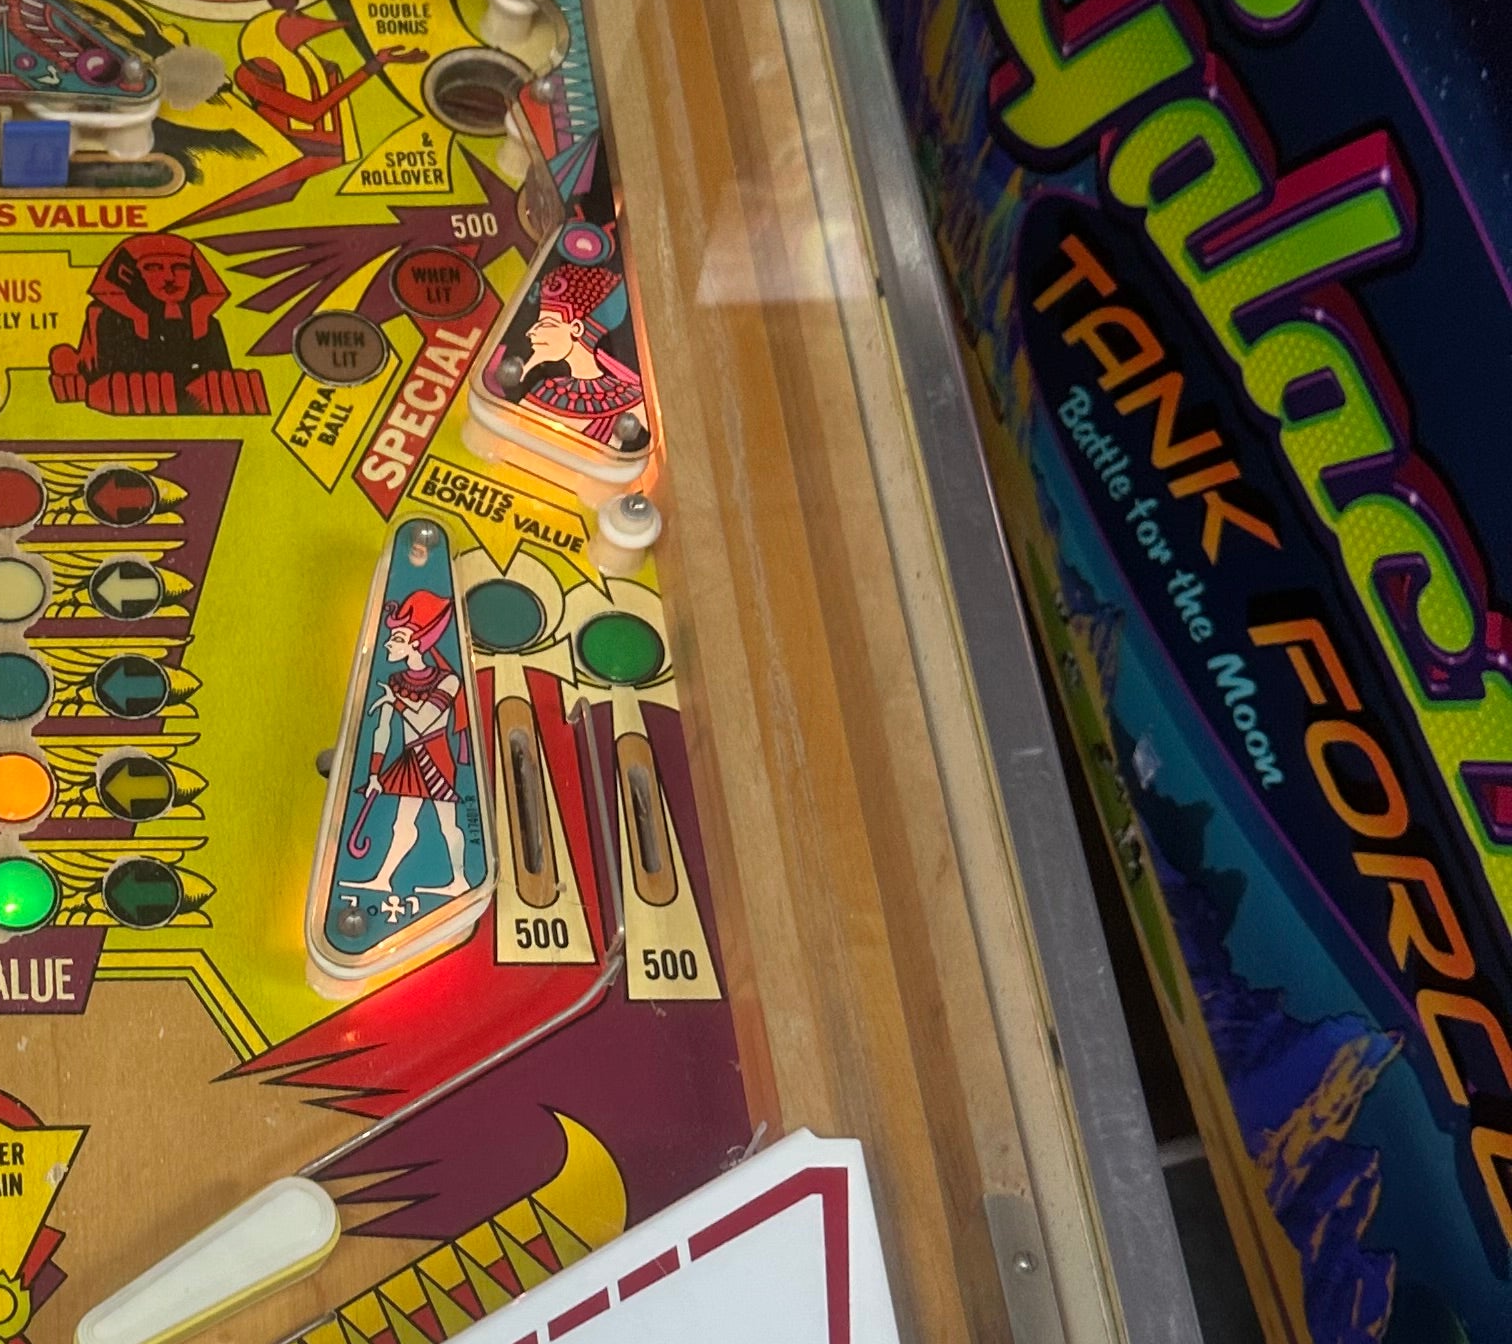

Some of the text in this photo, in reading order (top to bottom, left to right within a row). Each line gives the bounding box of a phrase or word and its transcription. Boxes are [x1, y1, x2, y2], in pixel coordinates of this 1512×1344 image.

[368, 3, 431, 19] DOUBLE
[377, 19, 428, 35] BONUS
[422, 132, 433, 148] &
[384, 150, 438, 168] SPOTS
[361, 168, 445, 187] ROLLOVER
[26, 205, 148, 229] VALUE
[451, 212, 499, 239] 500
[411, 266, 461, 284] WHEN
[426, 288, 452, 305] LIT
[31, 312, 59, 330] LIT
[315, 330, 365, 348] WHEN
[332, 352, 357, 369] LIT
[361, 327, 482, 489] SPECIAL
[1032, 233, 1283, 566] TANK
[289, 387, 337, 448] EXTRA
[317, 404, 354, 447] BALL
[428, 466, 515, 509] LIGHTS
[420, 482, 585, 554] BONUS VALUE
[1057, 384, 1284, 791] Battle for the Moon
[515, 918, 569, 950] 500
[641, 949, 698, 981] 500
